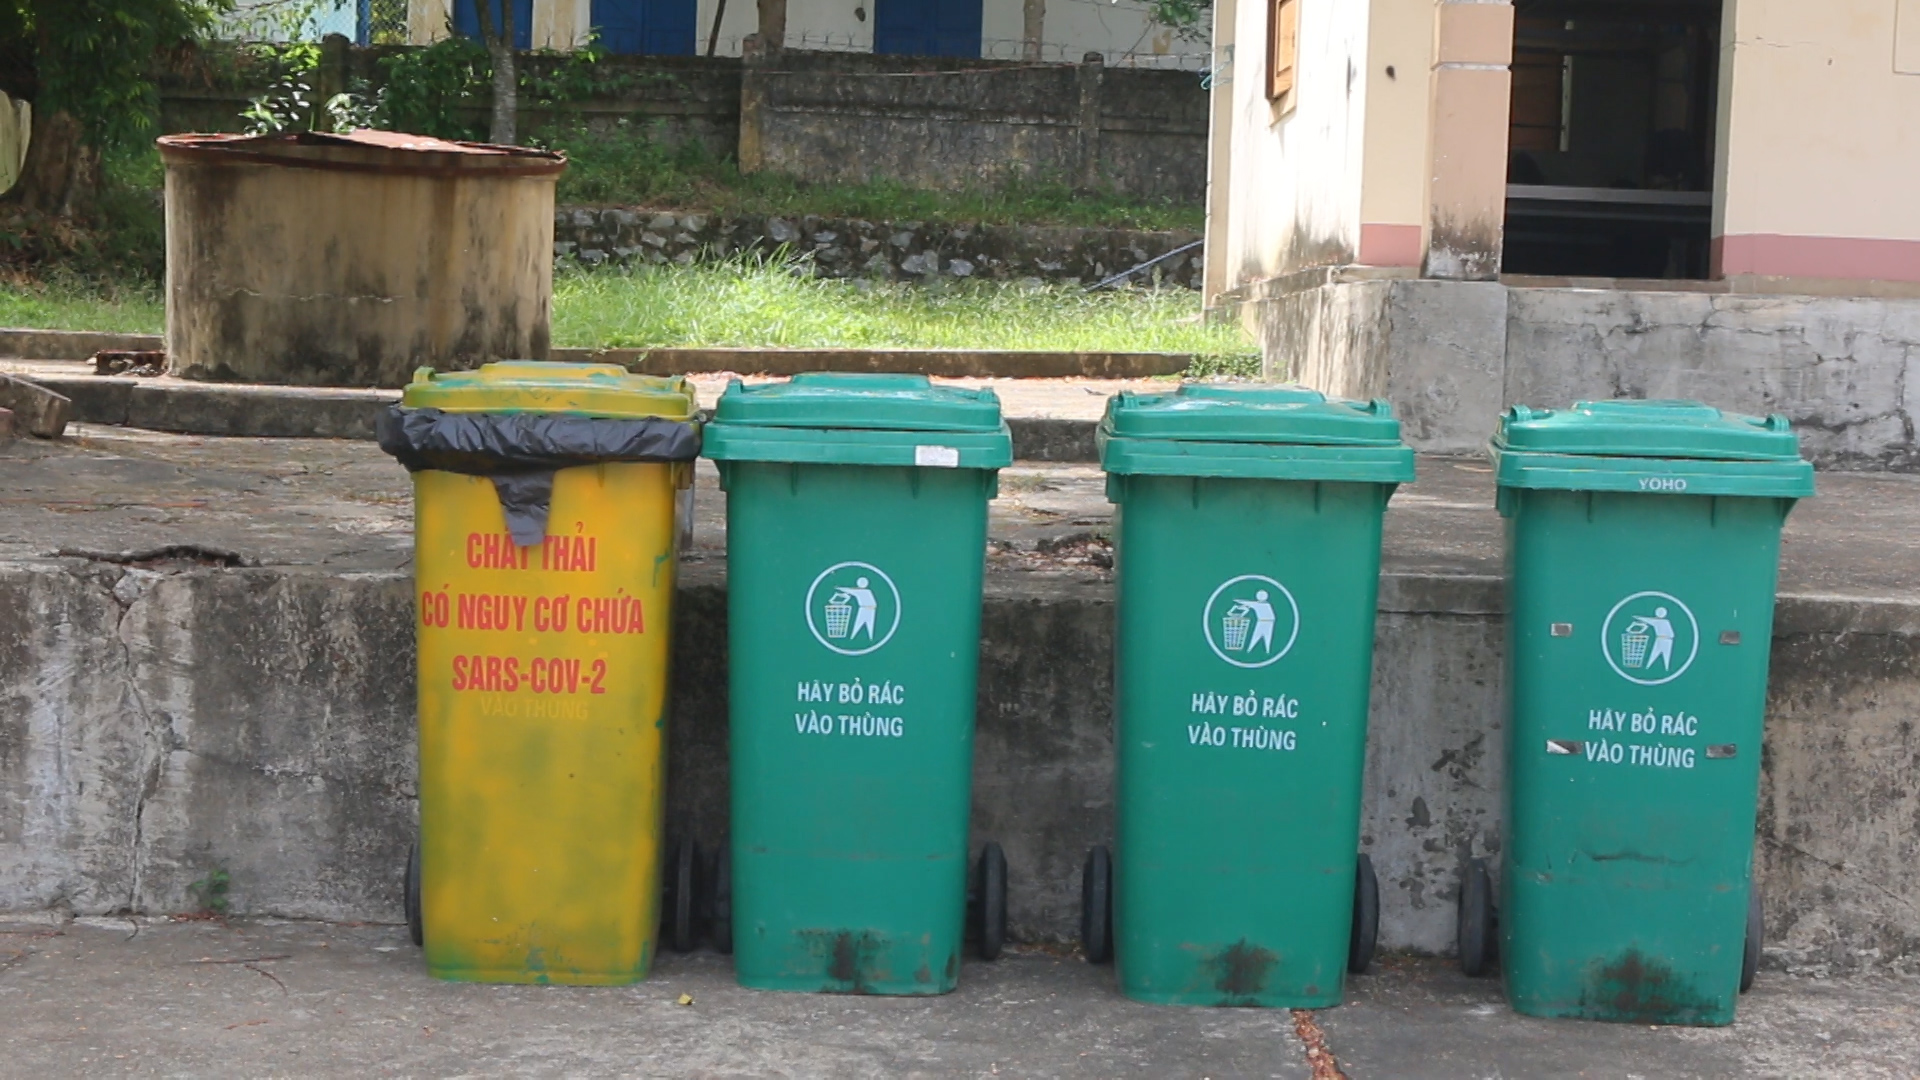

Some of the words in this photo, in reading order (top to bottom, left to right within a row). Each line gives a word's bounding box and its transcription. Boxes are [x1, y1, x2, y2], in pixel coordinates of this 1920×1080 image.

[1639, 477, 1687, 490] YOHO
[542, 521, 597, 572] THẢI
[422, 583, 450, 628] CÓ
[458, 593, 527, 632] NGUY
[534, 594, 570, 632] CƠ
[577, 587, 644, 634] CHỨA
[452, 655, 606, 694] SARS-COV-2
[838, 677, 863, 704] BỎ
[868, 680, 904, 705] RÁC
[1232, 689, 1258, 716] BỎ
[1262, 694, 1298, 718] RÁC
[794, 709, 833, 735] VÀO
[837, 711, 904, 737] THÙNG
[1187, 721, 1226, 746] VÀO
[1230, 725, 1297, 750] THÙNG
[1630, 706, 1656, 734] BỎ
[1661, 711, 1698, 736] RÁC
[1584, 738, 1624, 764] VÀO
[1629, 742, 1696, 768] THÙNG
